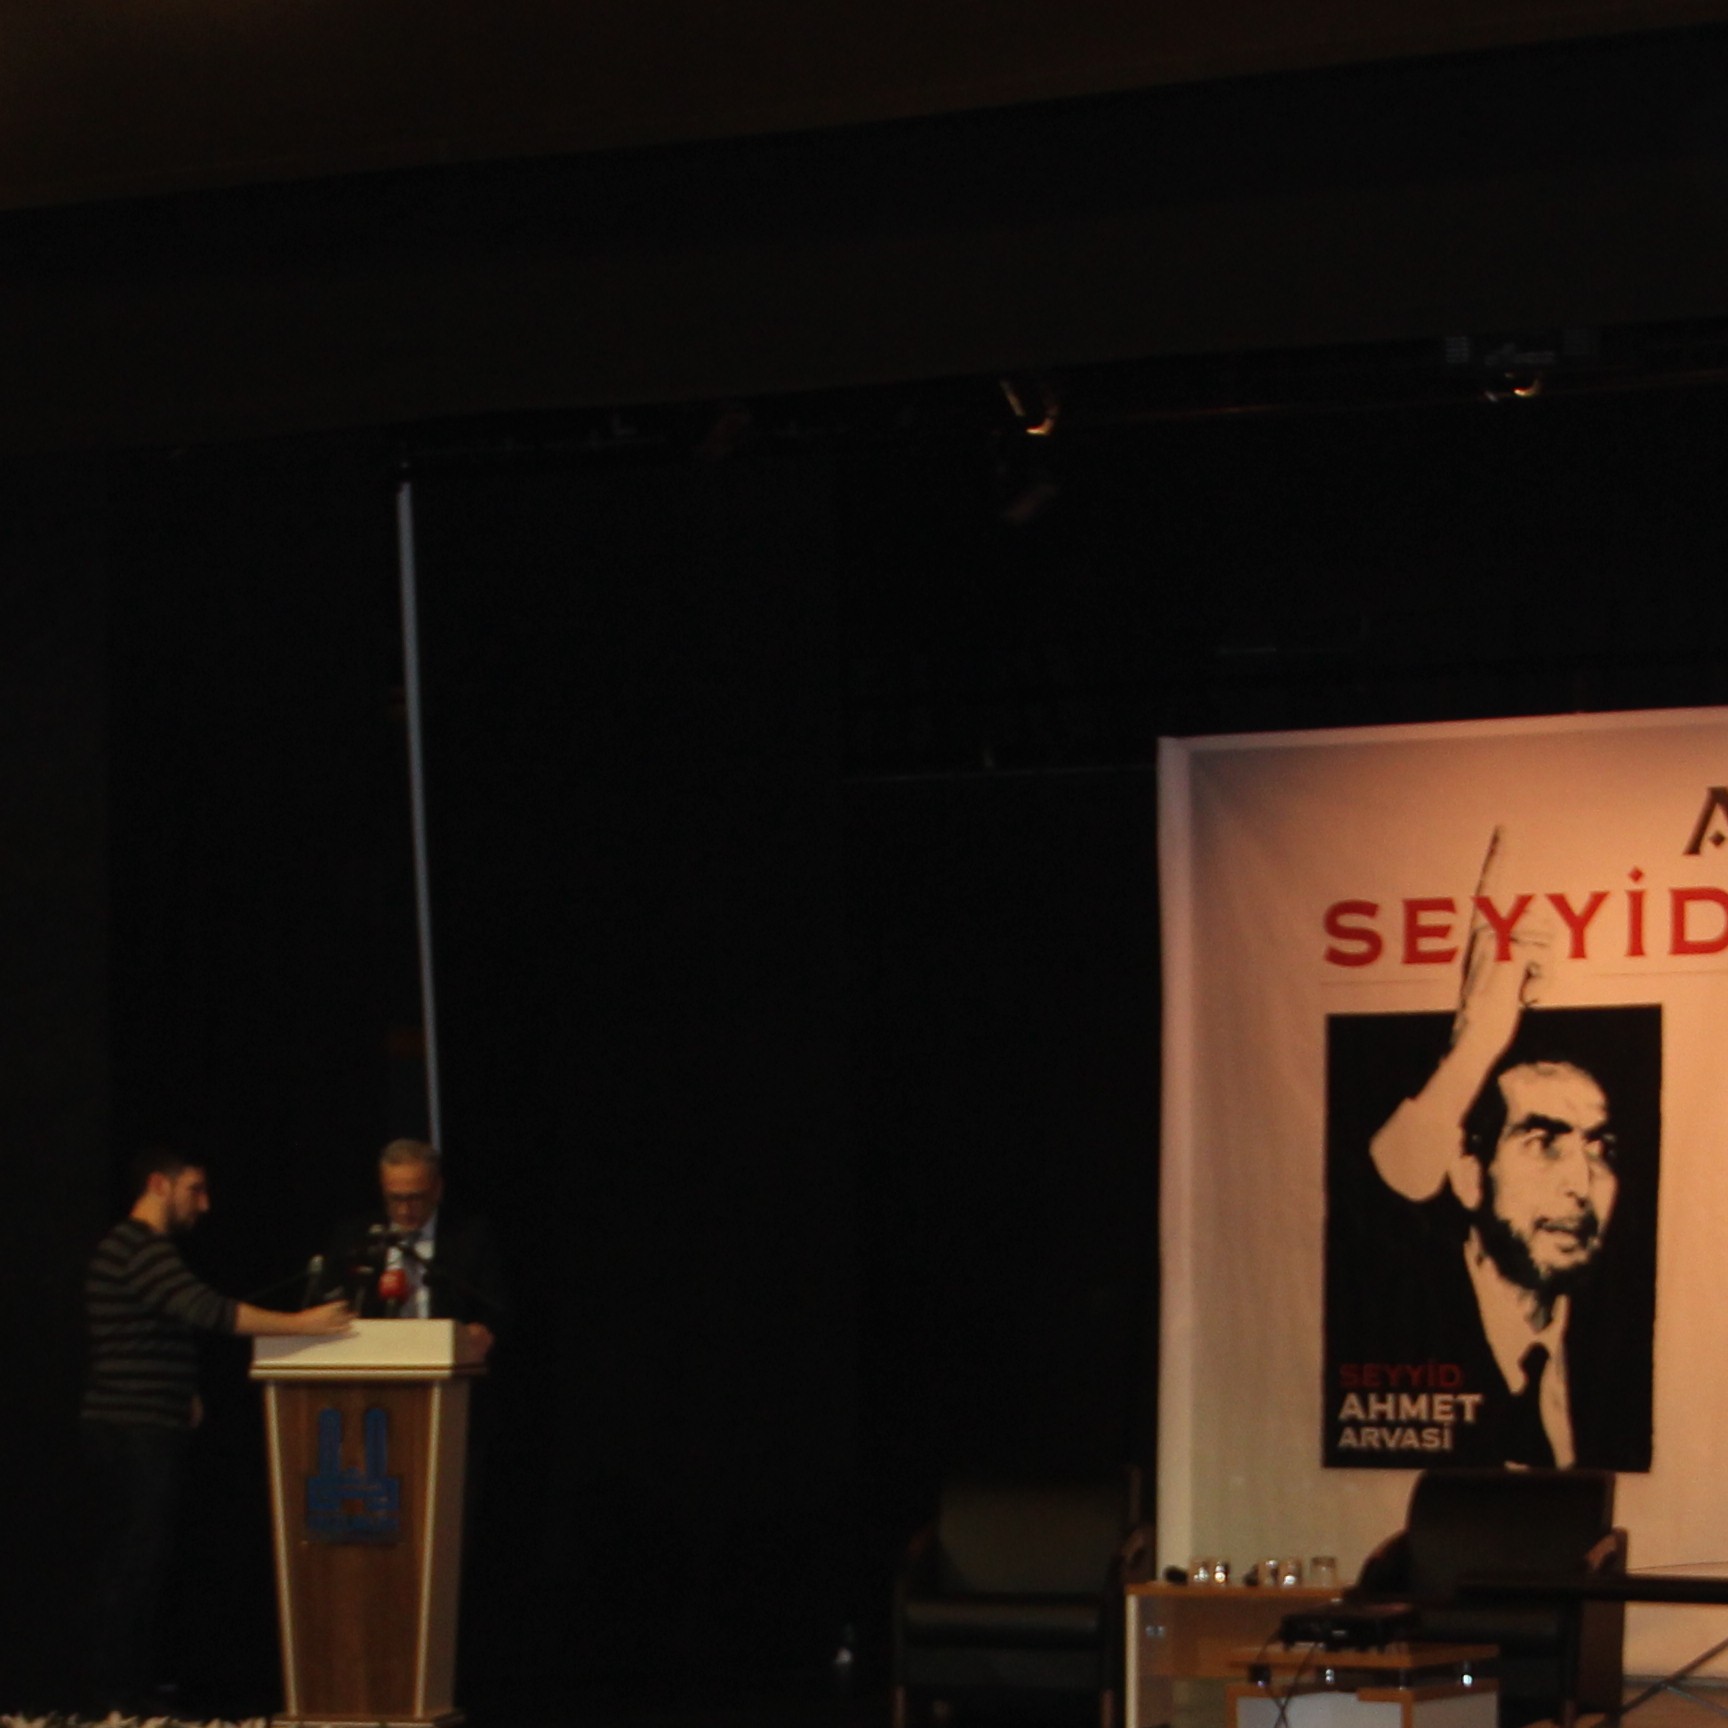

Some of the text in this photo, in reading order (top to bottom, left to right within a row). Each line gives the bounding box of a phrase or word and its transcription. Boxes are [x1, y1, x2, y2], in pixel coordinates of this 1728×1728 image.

[1338, 1359, 1464, 1387] SEYYİD
[1338, 1392, 1484, 1424] AHMET
[1337, 1423, 1454, 1450] ARVASİ
